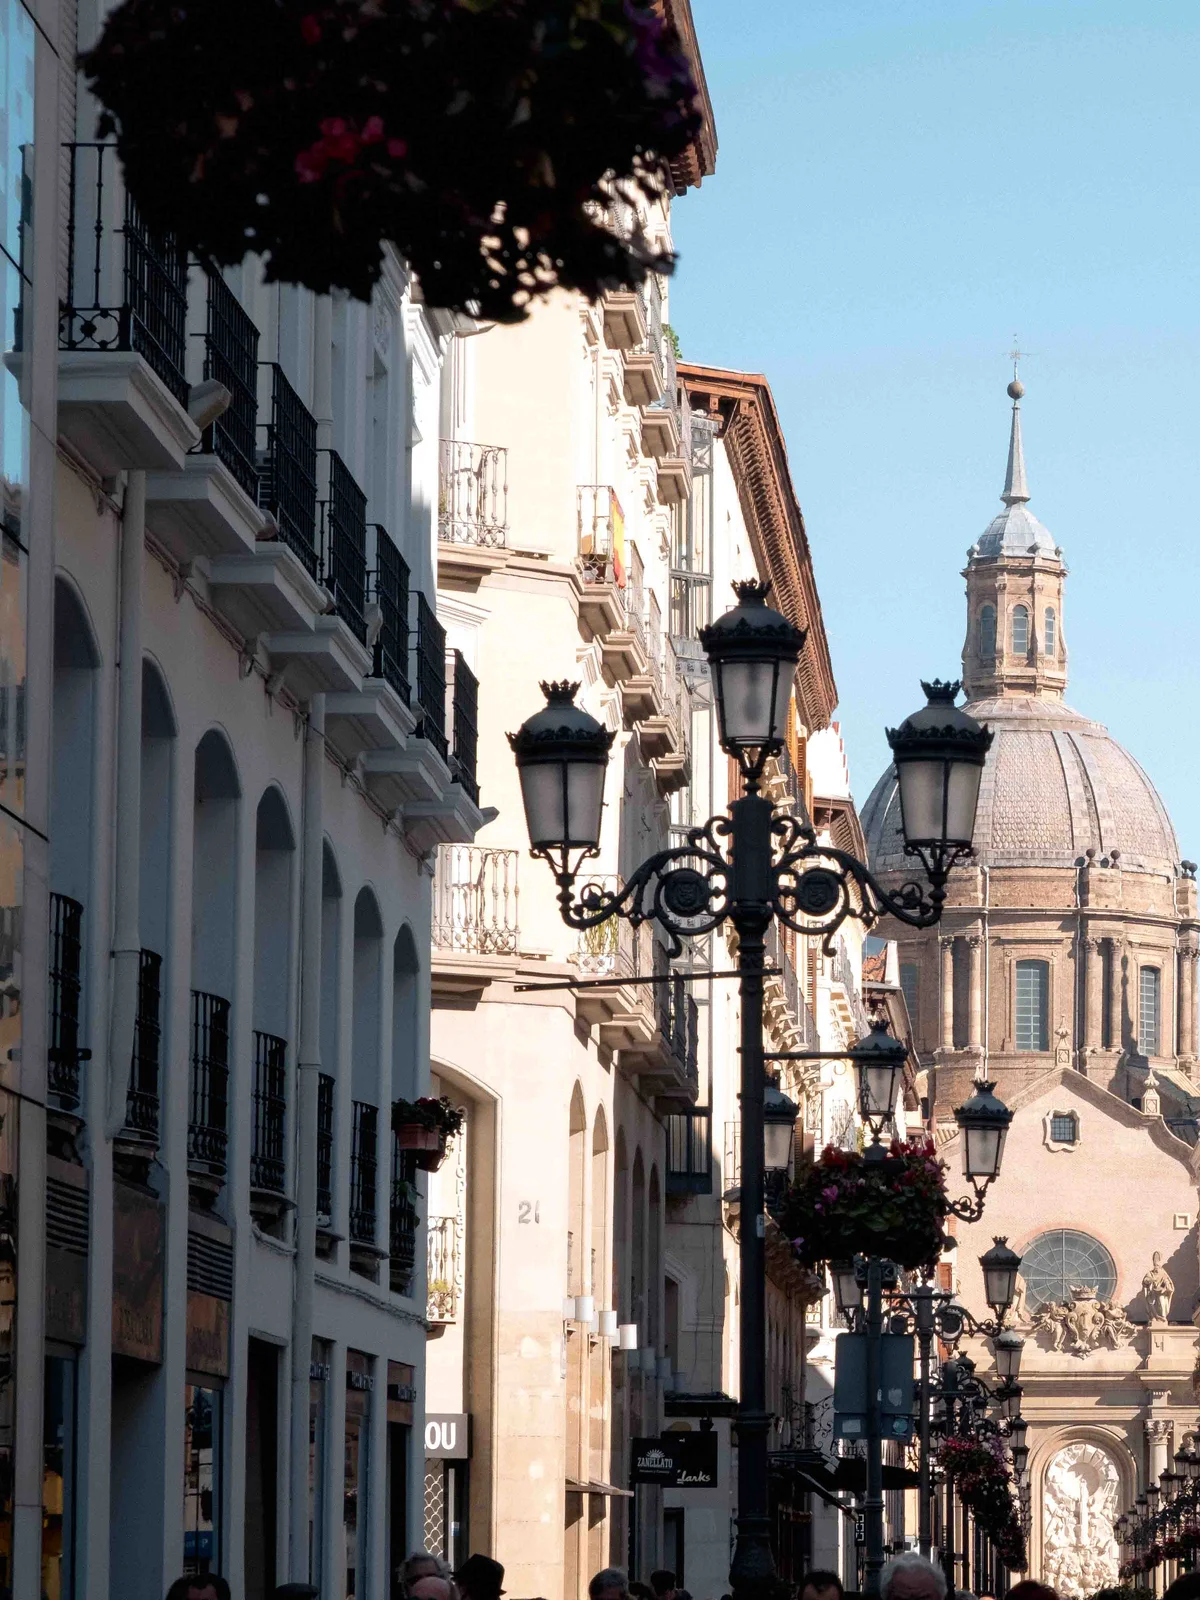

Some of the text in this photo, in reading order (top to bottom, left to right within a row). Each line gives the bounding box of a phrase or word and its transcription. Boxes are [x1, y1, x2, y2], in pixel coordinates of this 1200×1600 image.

[518, 1200, 540, 1224] 21
[424, 1421, 457, 1450] OU
[637, 1457, 673, 1468] ZANELLATO
